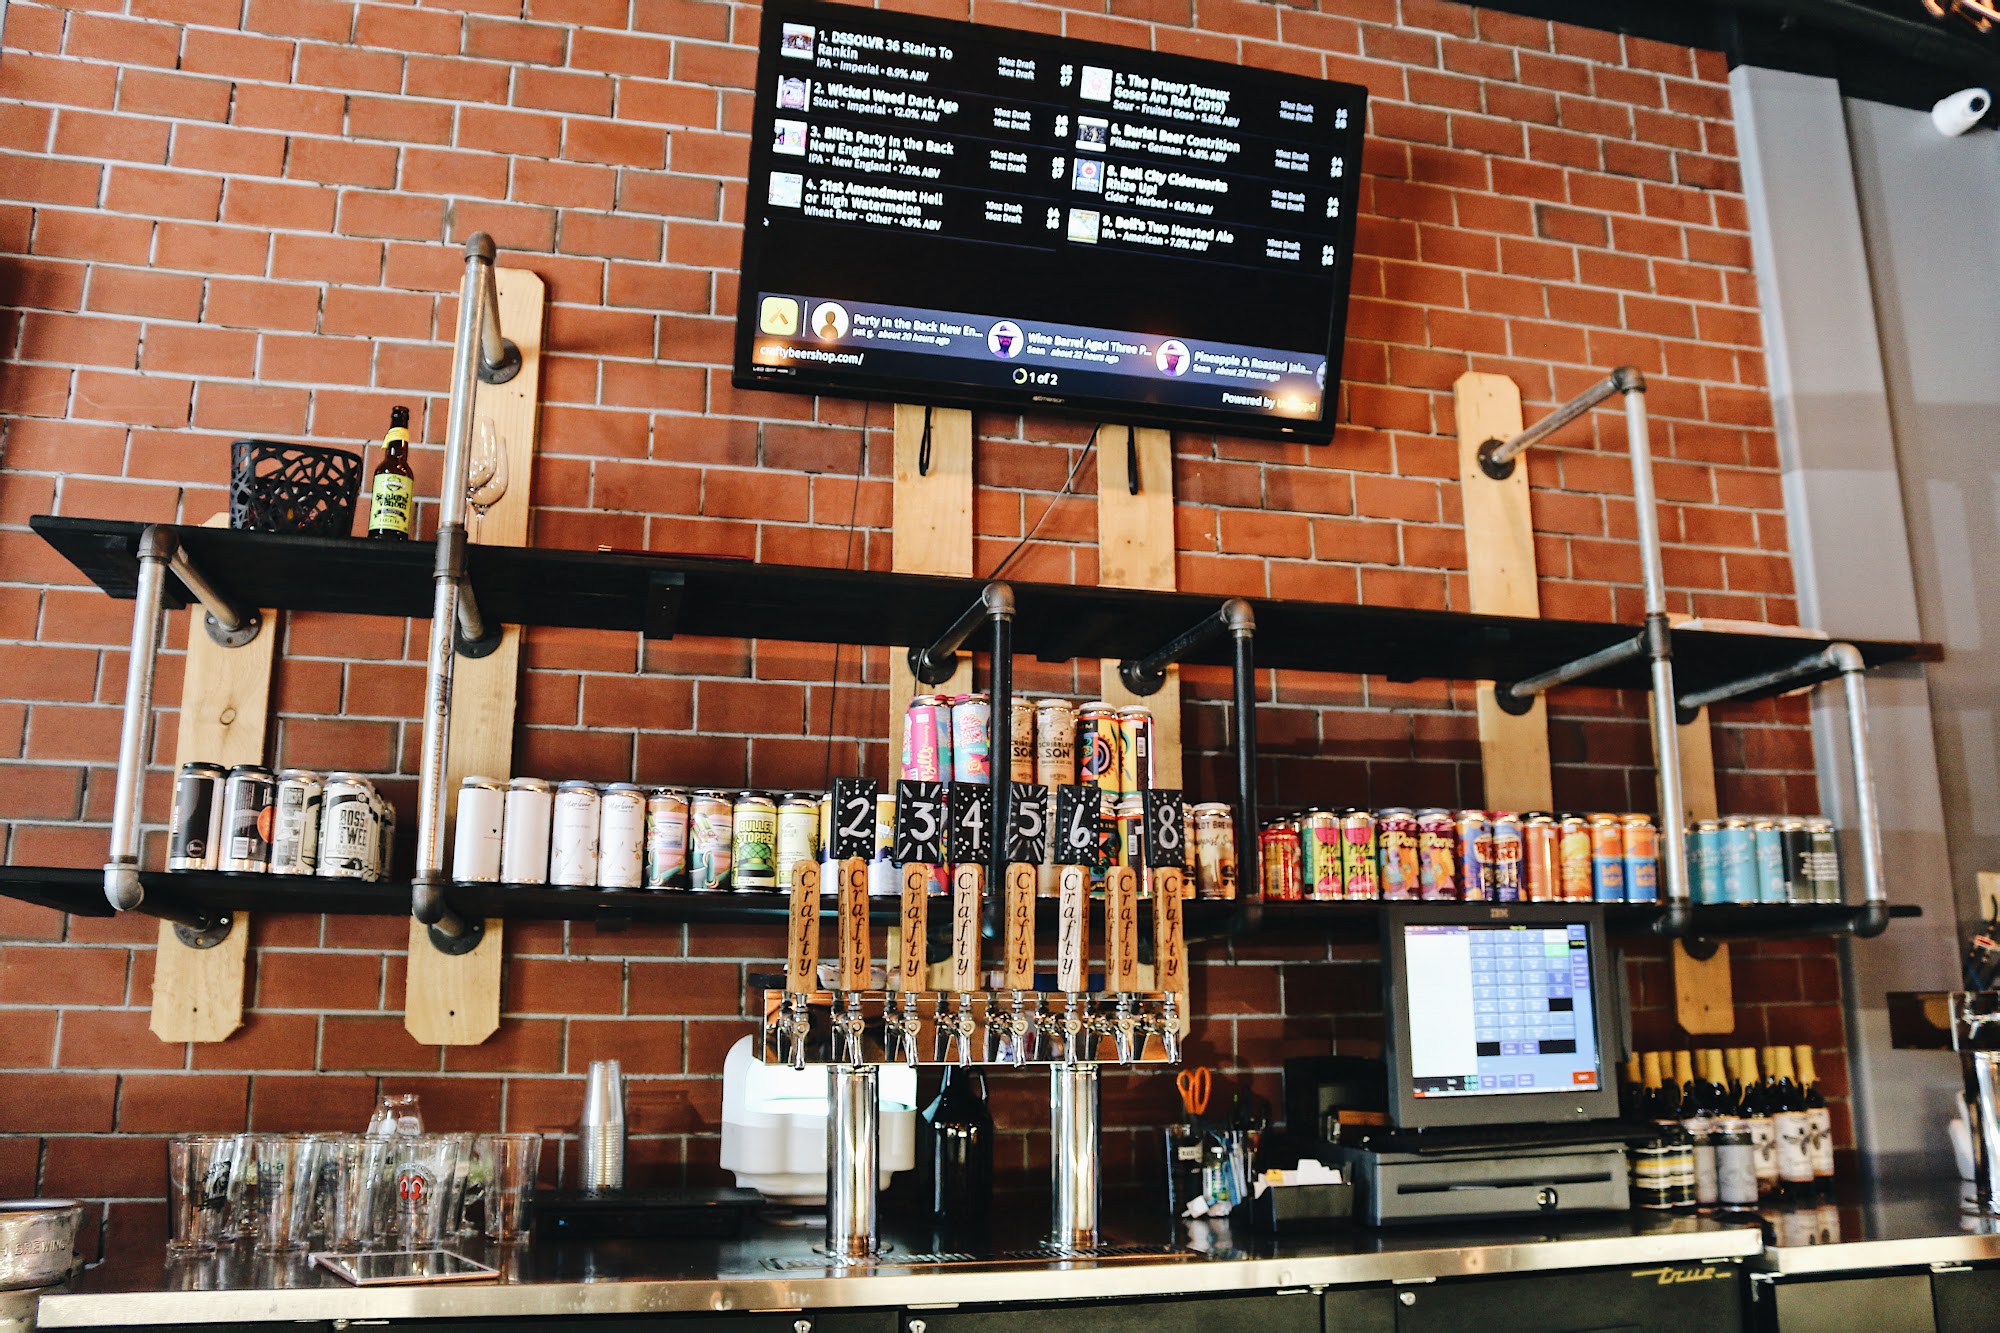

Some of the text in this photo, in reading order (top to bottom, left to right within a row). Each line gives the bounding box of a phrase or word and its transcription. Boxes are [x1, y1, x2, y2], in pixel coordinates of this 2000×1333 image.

[817, 44, 858, 60] Rankin
[818, 30, 953, 60] 1. DSSOLVR 36 Stairs To
[816, 58, 928, 82] IPA Imperial 8.9% ABV
[1115, 73, 1125, 86] 5.
[1127, 75, 1149, 89] The
[1150, 78, 1187, 96] Bruery
[812, 96, 838, 109] Stout
[847, 101, 886, 117] Imperial
[920, 110, 939, 122] ABV
[813, 82, 958, 114] 2. Wicked Weed Dark Age
[1148, 92, 1168, 105] Are
[1170, 95, 1191, 108] Red
[1193, 98, 1225, 114] (2019)
[1112, 100, 1134, 112] Sour
[1172, 108, 1195, 121] Gose
[1222, 115, 1239, 127] ABV
[809, 139, 907, 162] New England IPA
[810, 125, 954, 155] 3. Bill's Party the Back
[1109, 137, 1140, 151] Pilsner
[1147, 142, 1181, 156] German
[1209, 151, 1227, 162] ABV
[1110, 123, 1240, 152] 6. Burial Beer Contrition
[808, 154, 940, 178] IPA New England 7.0% ABV
[1106, 165, 1228, 193] 8. Bull City Ciderworks
[805, 177, 943, 206] 4. 21st Amendment Hell
[1138, 182, 1157, 197] Up!
[804, 194, 921, 216] or High Watermelon
[1104, 192, 1128, 204] Cider
[1195, 204, 1213, 215] ABV
[803, 205, 834, 218] Wheat
[835, 209, 857, 221] Beer
[865, 212, 892, 225] Other
[922, 219, 941, 230] ABV
[1102, 214, 1113, 228] 9.
[1146, 220, 1169, 235] Two
[1171, 223, 1214, 241] Hearted
[1215, 229, 1234, 243] Ale
[1101, 228, 1208, 251] IPA American 7.0% ABV
[853, 314, 983, 338] Party the Back New En...
[759, 345, 864, 366] craftybeershop.com/
[1027, 333, 1052, 346] Wine
[1054, 335, 1083, 349] Barrel
[1084, 338, 1109, 354] Aged
[1110, 341, 1138, 354] Three
[1194, 350, 1240, 368] Pineapple
[1251, 356, 1287, 371] Roasted
[1029, 372, 1058, 385] 1 of 2
[1222, 392, 1262, 407] Powered
[1263, 397, 1278, 411] by
[1046, 748, 1070, 758] SON
[340, 810, 366, 828] BOSS
[739, 820, 774, 833] BULLET
[839, 797, 872, 838] 2
[910, 801, 936, 841] 3
[962, 800, 984, 850] 4
[1019, 802, 1043, 837] 5
[1070, 803, 1091, 848] 6
[1158, 805, 1178, 849] 8
[737, 832, 776, 844] STOPPE
[800, 870, 816, 976] Crafty
[850, 870, 865, 974] Crafty
[907, 872, 923, 977] Crafty
[957, 872, 973, 975] Crafty
[1015, 872, 1031, 974] Crafty
[1062, 873, 1078, 975] Crafty
[1120, 875, 1132, 976] Crafty
[1164, 875, 1179, 976] Crafty
